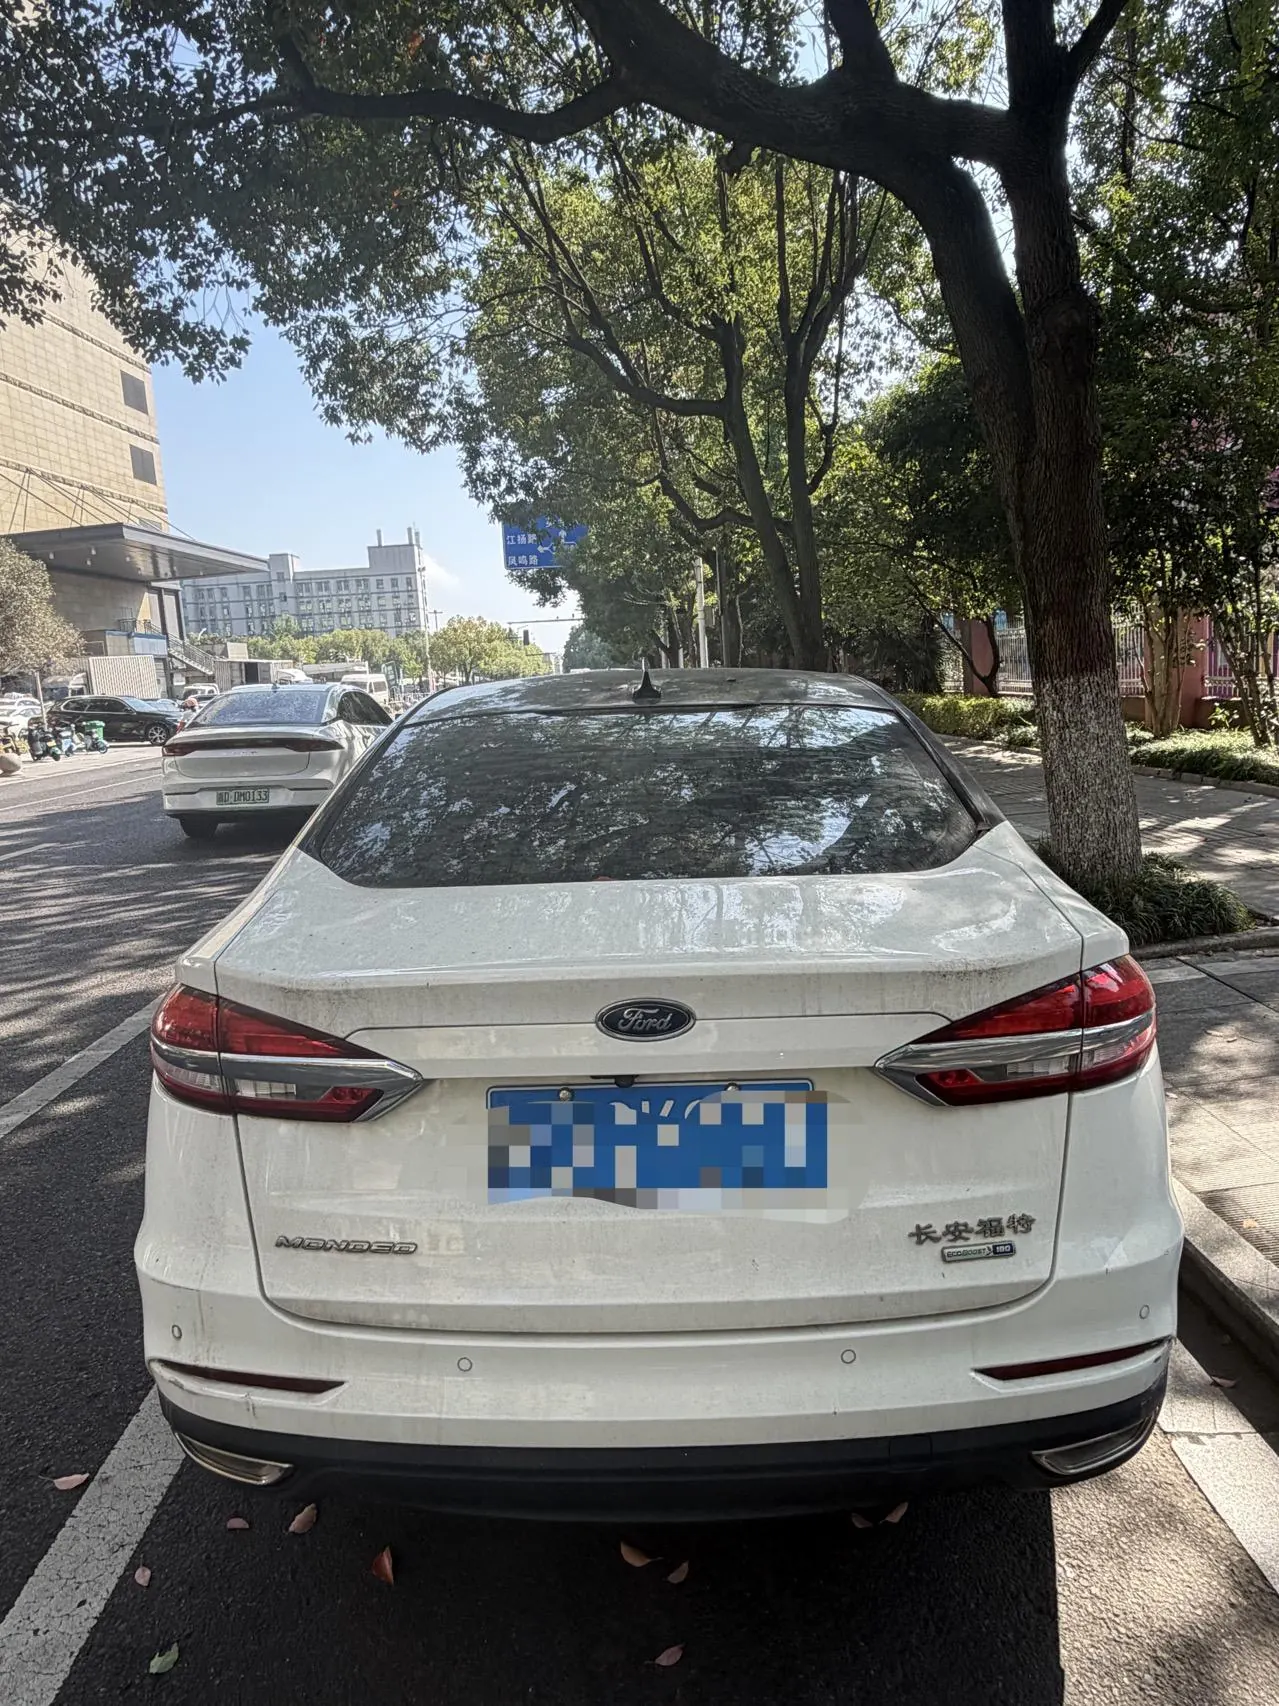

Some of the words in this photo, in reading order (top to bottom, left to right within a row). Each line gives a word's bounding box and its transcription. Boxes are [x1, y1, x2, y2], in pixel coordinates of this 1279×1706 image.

[618, 1007, 673, 1031] Ford
[908, 1213, 1037, 1246] 长安福特
[275, 1235, 418, 1255] MONDEO
